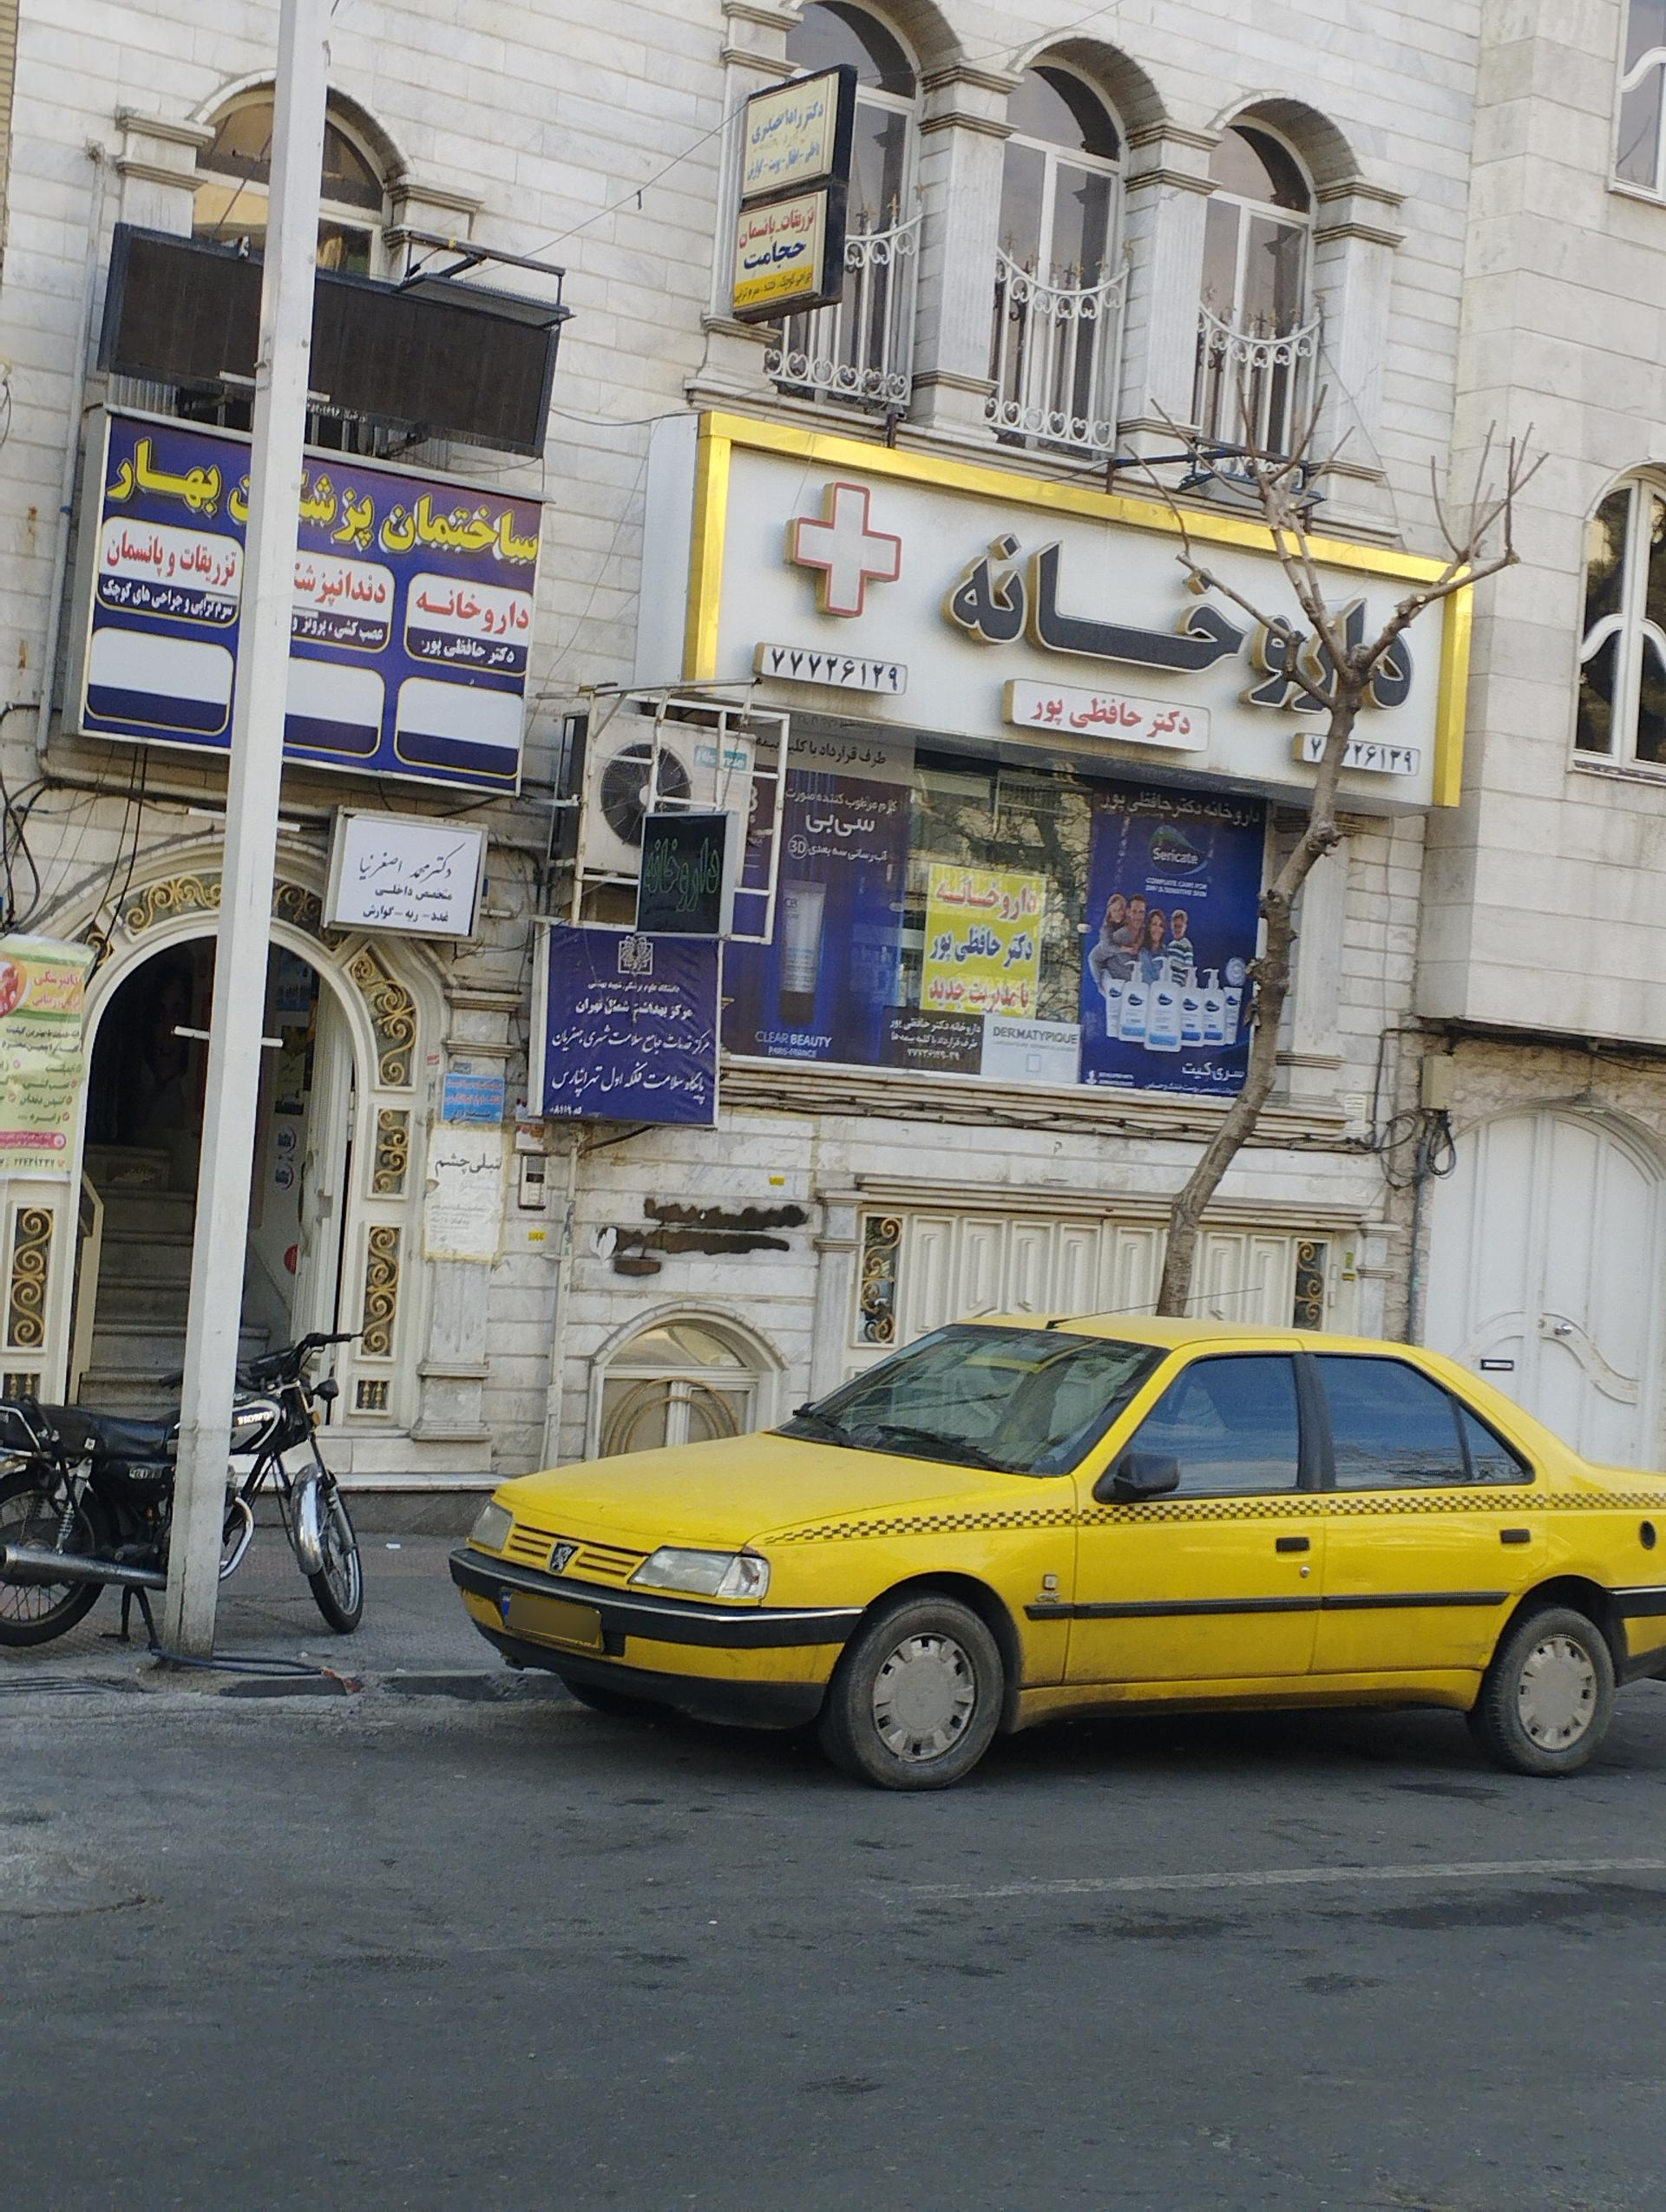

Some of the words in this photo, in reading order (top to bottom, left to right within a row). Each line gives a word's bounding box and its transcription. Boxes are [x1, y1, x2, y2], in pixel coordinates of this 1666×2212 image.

[744, 240, 807, 270] حجامت
[107, 437, 222, 517] بهار
[382, 493, 540, 566] ساختمان
[107, 529, 164, 577] پانسمان
[166, 552, 176, 578] و
[180, 543, 238, 587] تزریقات
[416, 589, 529, 635] داروخانه
[944, 532, 1416, 715] داروخانه
[443, 638, 486, 658] حافظی
[487, 645, 515, 664] دکتر
[1029, 697, 1064, 726] پور
[1069, 697, 1144, 729] حافظی
[1145, 710, 1191, 737] دکتر
[809, 740, 817, 758] با
[818, 742, 858, 764] قرارداد
[859, 748, 887, 768] طرف
[1099, 793, 1126, 810] پور
[1129, 791, 1172, 813] حافظی
[1172, 796, 1203, 818] دکتر
[1204, 802, 1260, 827] داروخانه
[790, 840, 807, 854] 3D
[1152, 847, 1198, 865] Sericate
[419, 841, 467, 884] دکتر
[374, 884, 413, 897] داخلی
[415, 888, 453, 901] متخصص
[935, 876, 1037, 920] داروخانه
[404, 910, 419, 923] ریه
[430, 912, 449, 923] غدد
[929, 933, 952, 961] پور
[954, 926, 1001, 963] حافظی
[1002, 933, 1033, 968] دکتر
[669, 1003, 693, 1020] مرکز
[582, 1024, 612, 1049] شهری
[608, 1031, 643, 1046] سلامت
[755, 1030, 790, 1044] CLEAR
[790, 1033, 833, 1048] BEAUTY
[993, 1026, 1079, 1044] DERMATYPIQUE
[600, 1066, 625, 1092] اول
[642, 1073, 684, 1091] سلامت
[434, 1152, 470, 1178] چشم
